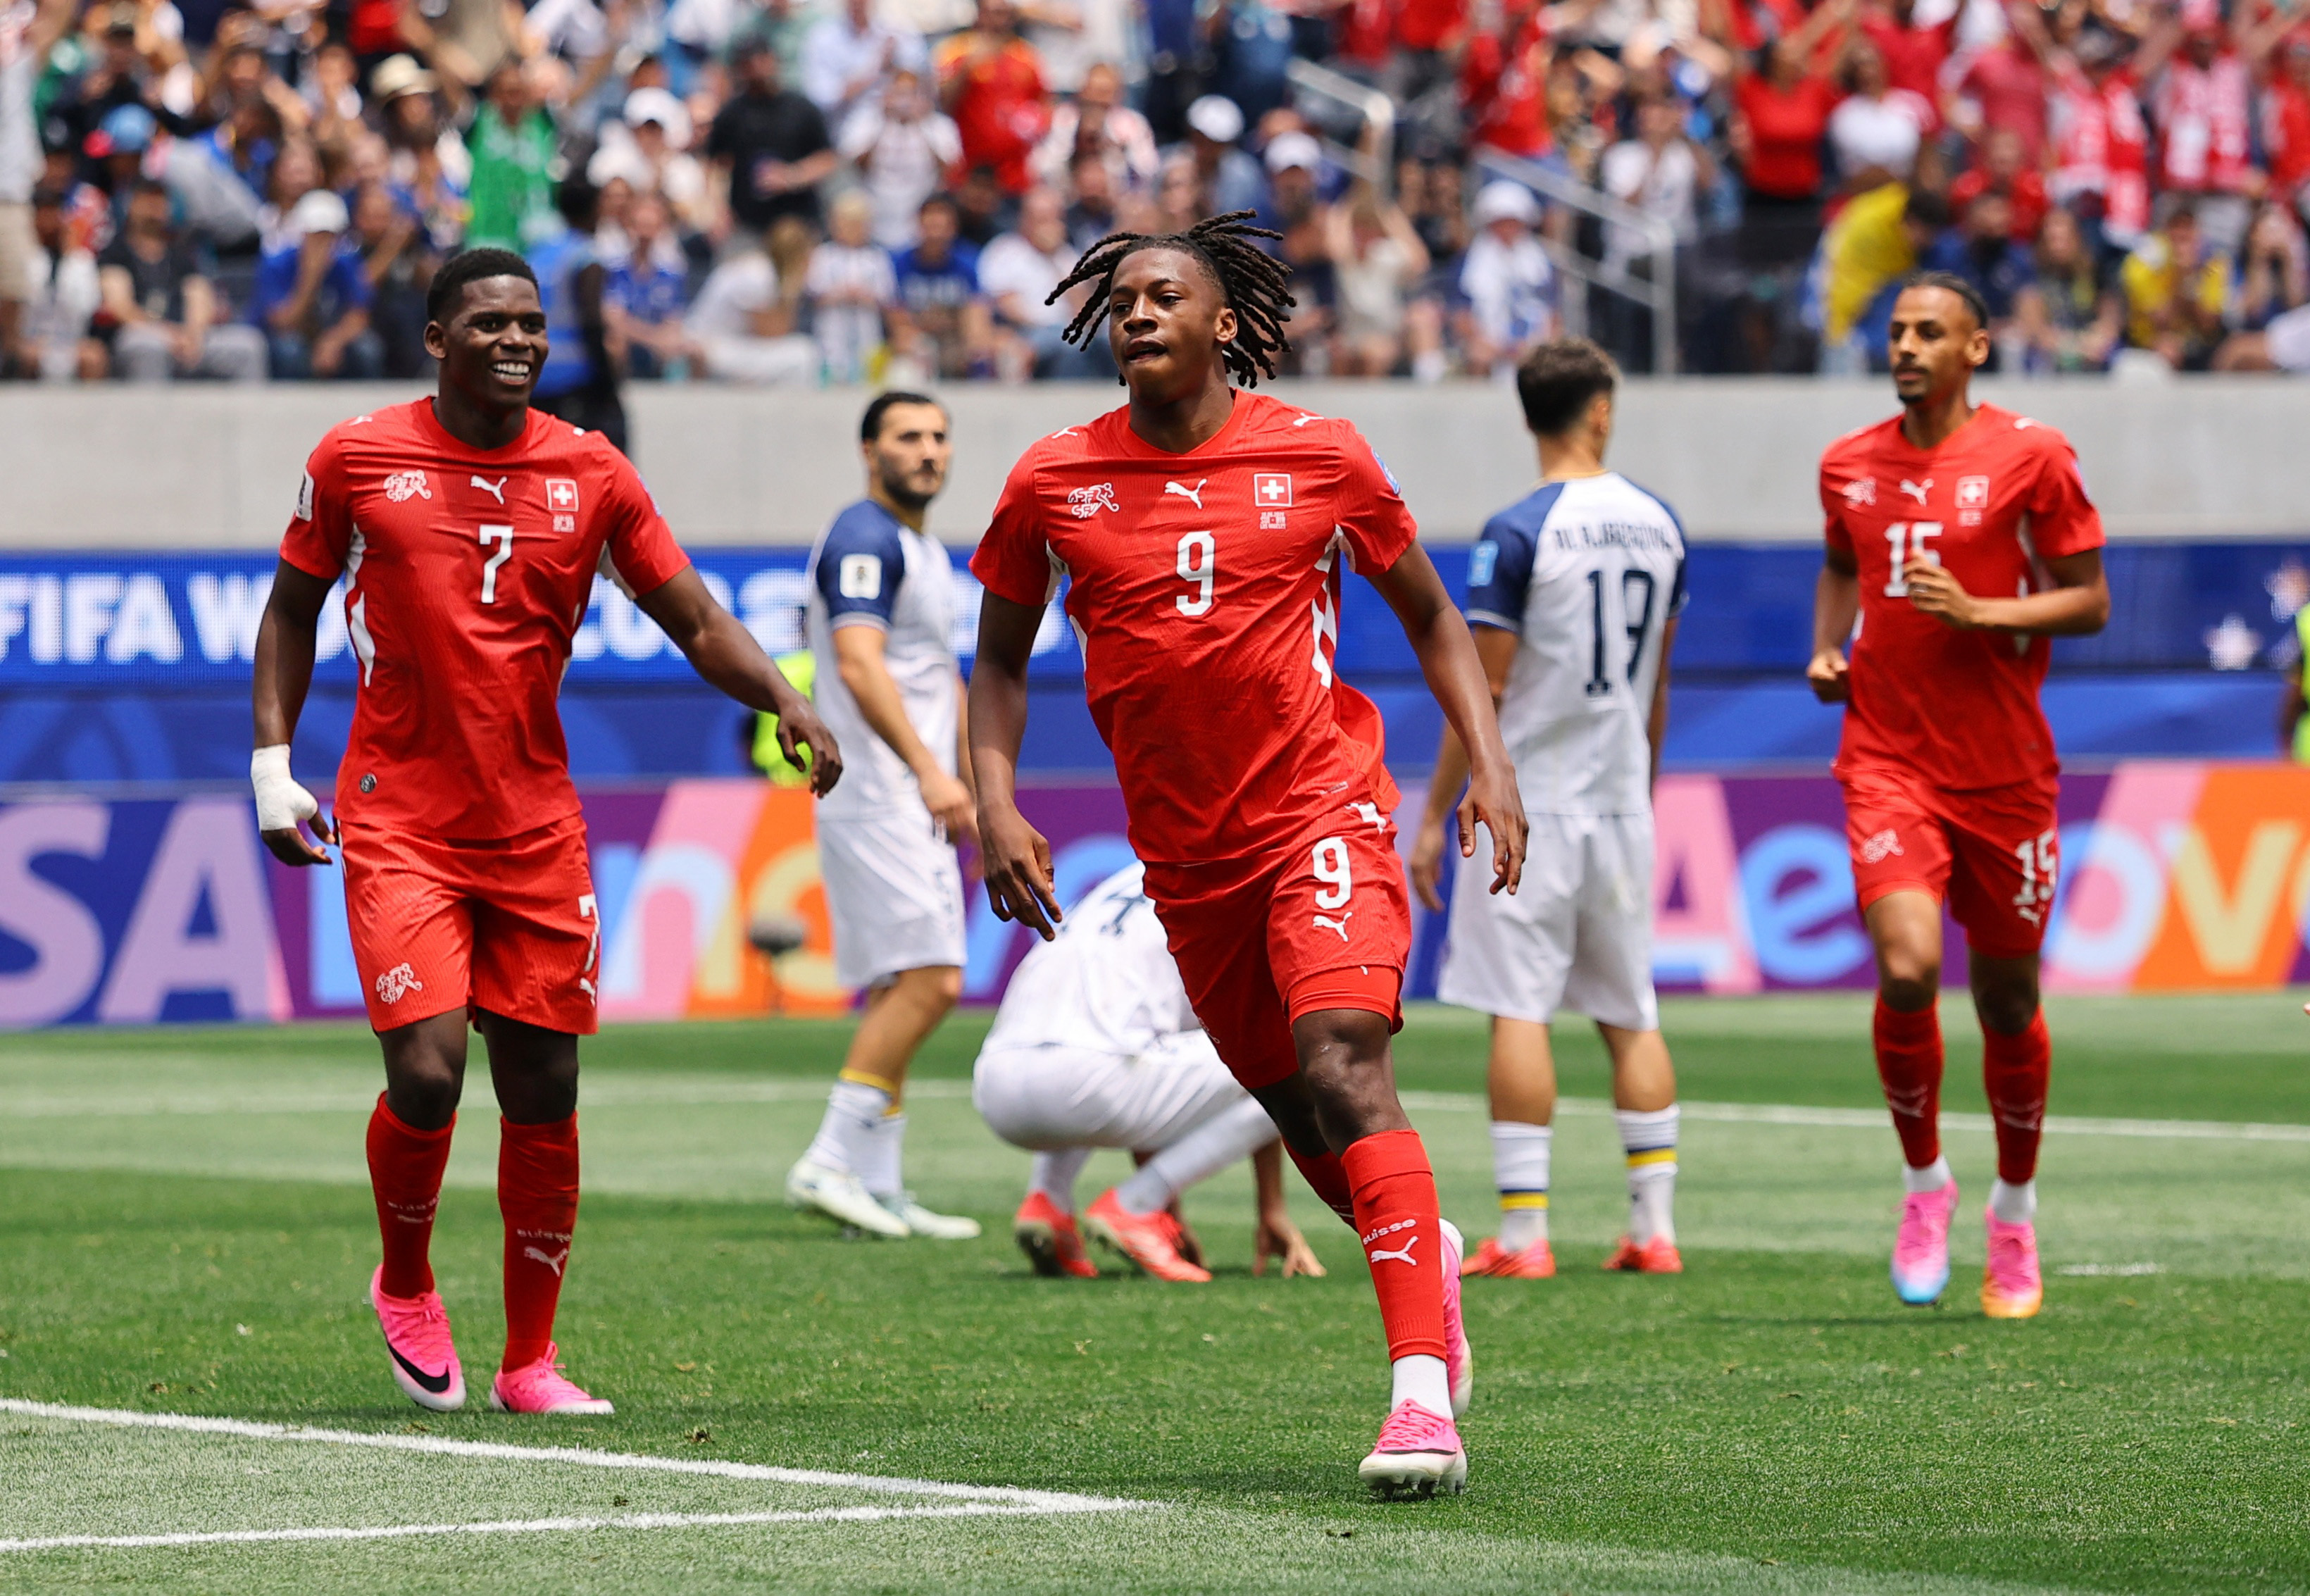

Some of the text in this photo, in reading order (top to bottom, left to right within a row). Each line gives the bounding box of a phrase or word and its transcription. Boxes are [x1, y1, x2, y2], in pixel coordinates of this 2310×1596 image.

[479, 524, 513, 604] 7
[1175, 530, 1216, 616] 9
[0, 572, 184, 664] FIFA
[1311, 836, 1351, 910] 9
[2012, 828, 2056, 906] 15
[578, 893, 600, 972] 7
[1363, 1218, 1417, 1245] suisse
